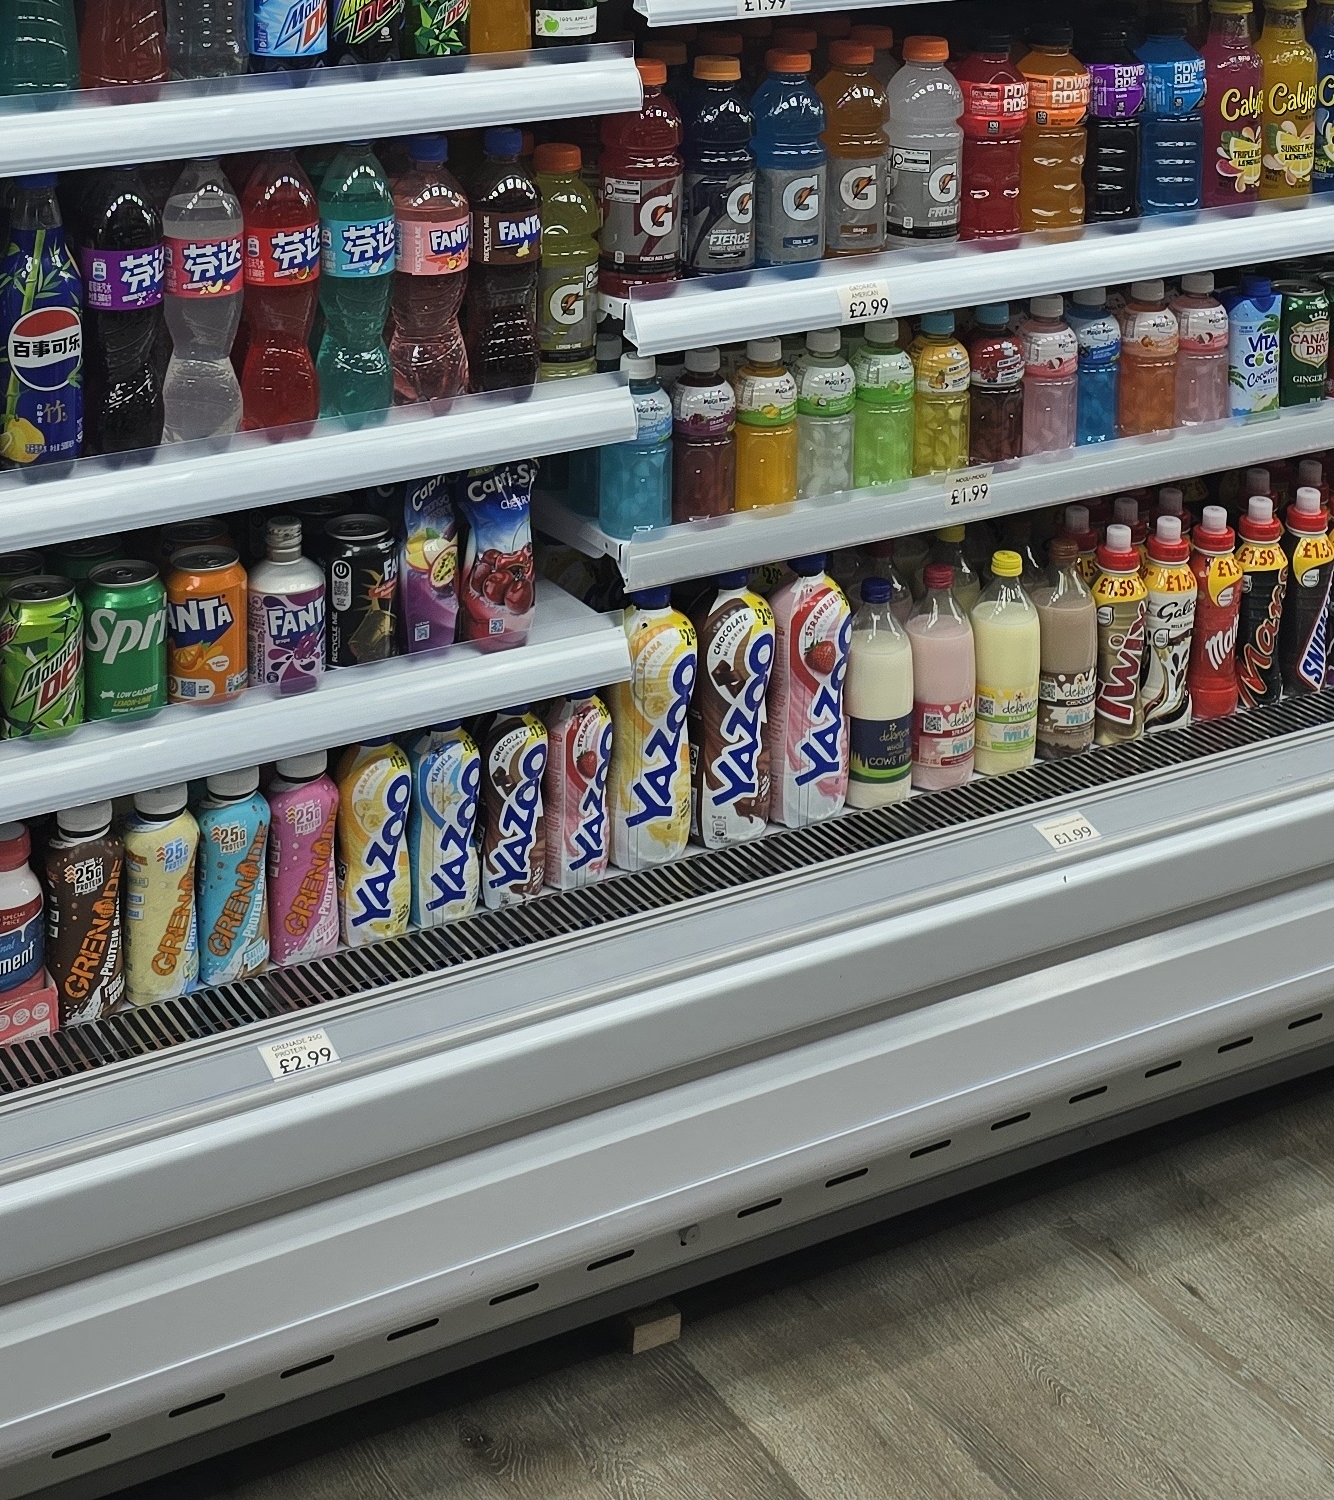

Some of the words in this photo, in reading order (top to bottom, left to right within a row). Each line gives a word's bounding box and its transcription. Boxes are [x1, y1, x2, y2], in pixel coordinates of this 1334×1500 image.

[710, 232, 750, 246] FIERCE
[184, 243, 242, 280] 芬达
[849, 300, 889, 318] £2.99
[12, 327, 81, 358] 百事可乐
[951, 484, 988, 504] £1.99
[713, 613, 749, 656] CHOCOLATE
[712, 634, 773, 807] YAZOO
[490, 744, 548, 888] YAZOO
[1054, 826, 1092, 845] £1.99
[352, 774, 412, 927] YAZOO
[272, 1039, 309, 1051] GRENADE
[275, 1046, 304, 1058] PROTEIN
[279, 1048, 333, 1073] £2.99
